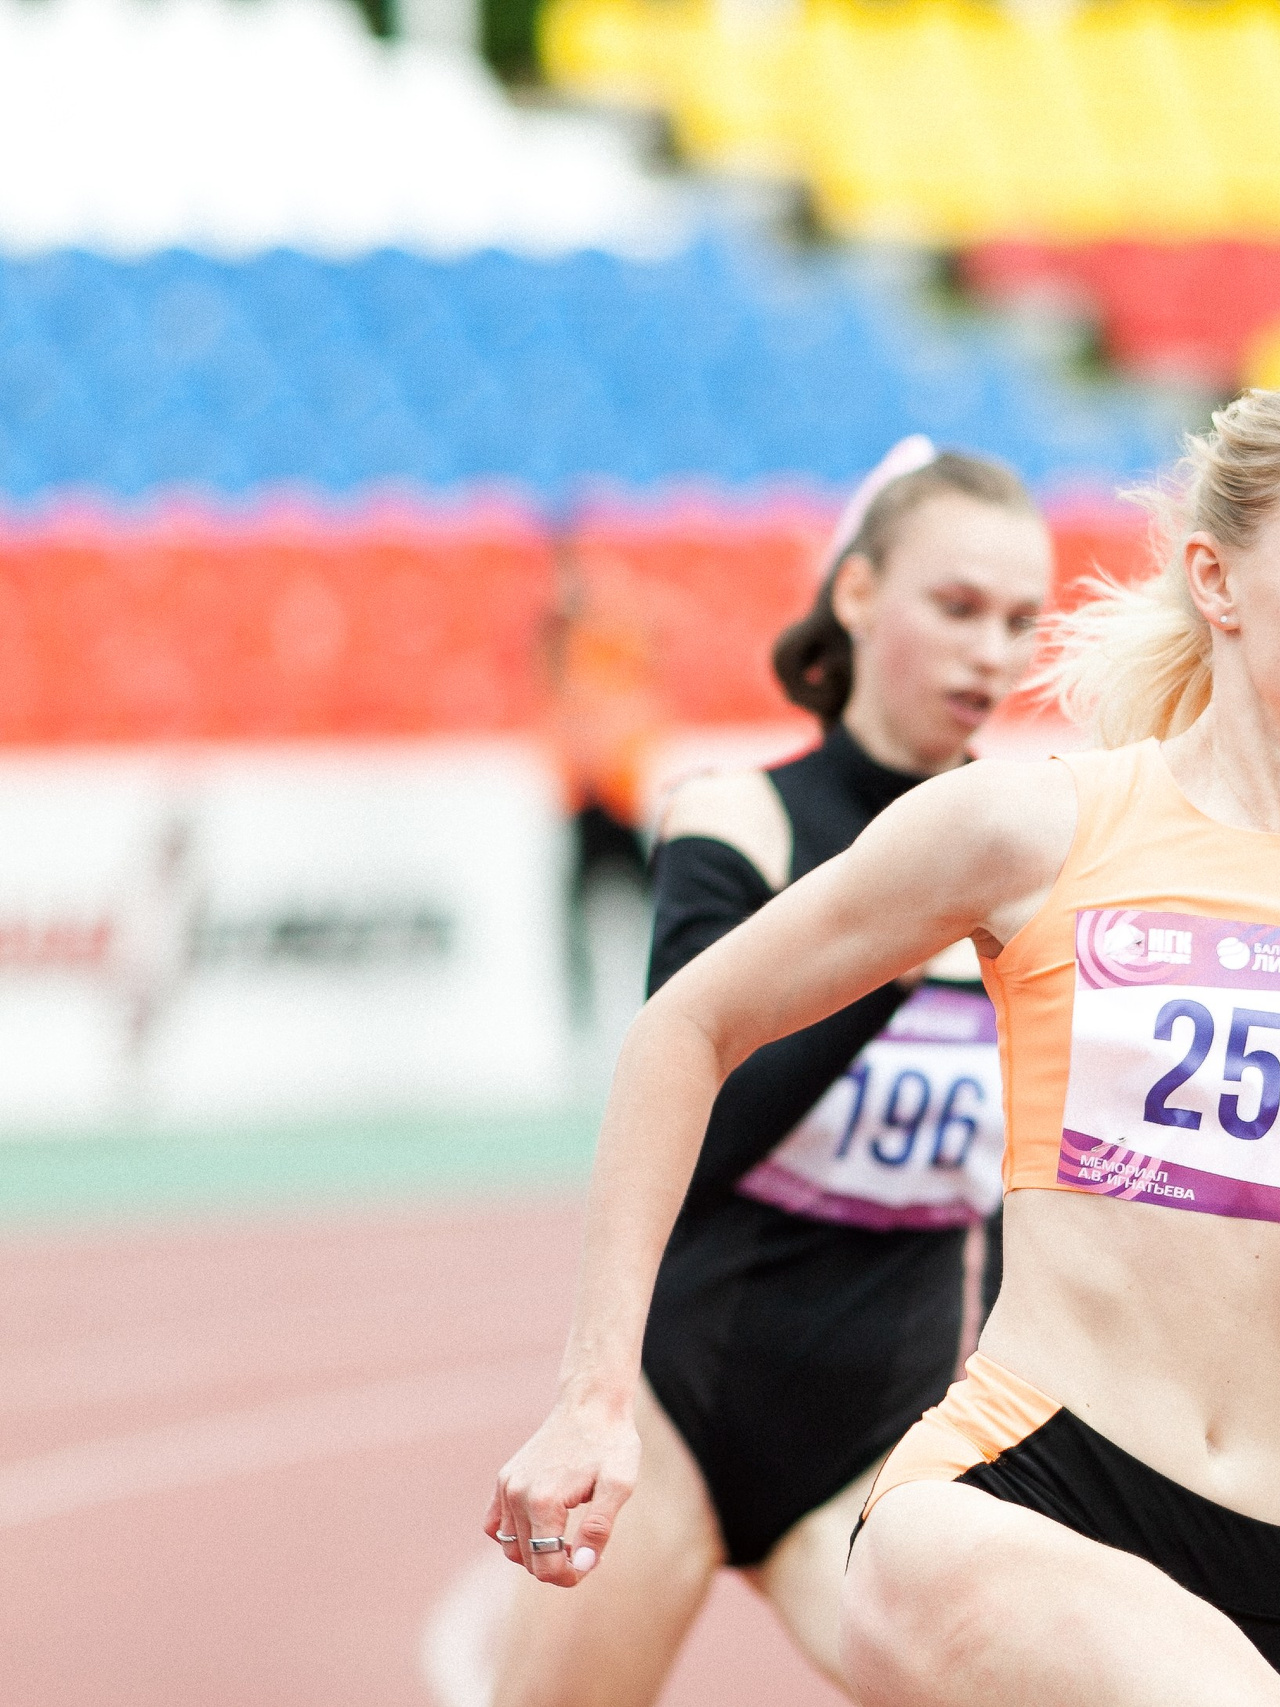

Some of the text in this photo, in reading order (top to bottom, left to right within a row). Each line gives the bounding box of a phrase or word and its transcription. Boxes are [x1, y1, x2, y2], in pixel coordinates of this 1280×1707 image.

[834, 1061, 986, 1168] 196
[1080, 1154, 1169, 1183] МЕМОРИАЛ
[1107, 1173, 1196, 1201] ИГНАТЬЕВА
